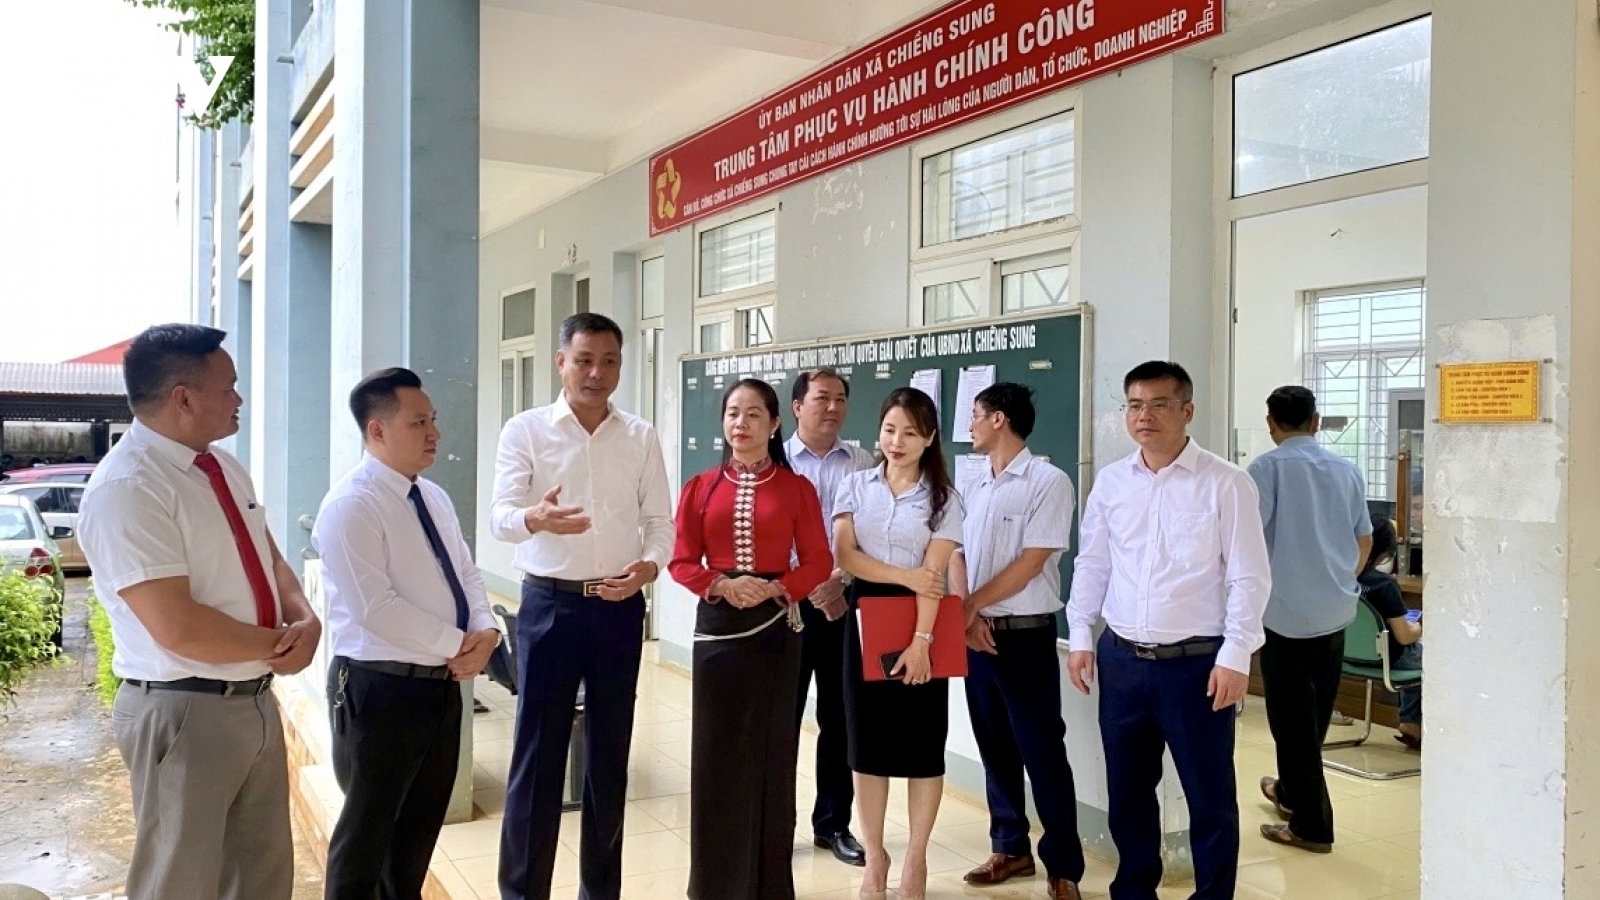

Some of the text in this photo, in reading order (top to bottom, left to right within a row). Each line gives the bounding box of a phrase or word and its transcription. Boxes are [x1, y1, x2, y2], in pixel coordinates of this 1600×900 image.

[713, 0, 1095, 182] TRUNG TÂM PHỤC VỤ HÀNH CHÍNH CÔNG
[754, 172, 769, 189] SUNG
[769, 165, 788, 184] CHUNG
[810, 147, 828, 167] CÁCH
[827, 140, 846, 160] HÀNH
[847, 131, 868, 153] CHÍNH
[909, 108, 922, 131] SỰ
[938, 96, 961, 120] LÒNG
[962, 84, 981, 110] CỦA
[983, 73, 1013, 102] NGƯỜI
[1014, 66, 1040, 91] DÂN,
[1042, 51, 1056, 80] TỔ
[1058, 46, 1092, 74] CHỨC,
[1094, 29, 1135, 61] DOANH
[1138, 8, 1187, 45] NGHIỆP
[759, 3, 995, 130] ỦY BAN NHÂN DÂN XÃ CHIỀNG SUNG
[895, 335, 918, 363] QUYẾT
[920, 333, 936, 358] CỦA
[938, 333, 960, 356] UBND
[960, 329, 972, 355] XÃ
[975, 325, 1008, 352] CHIỀNG
[1009, 324, 1036, 350] SUNG
